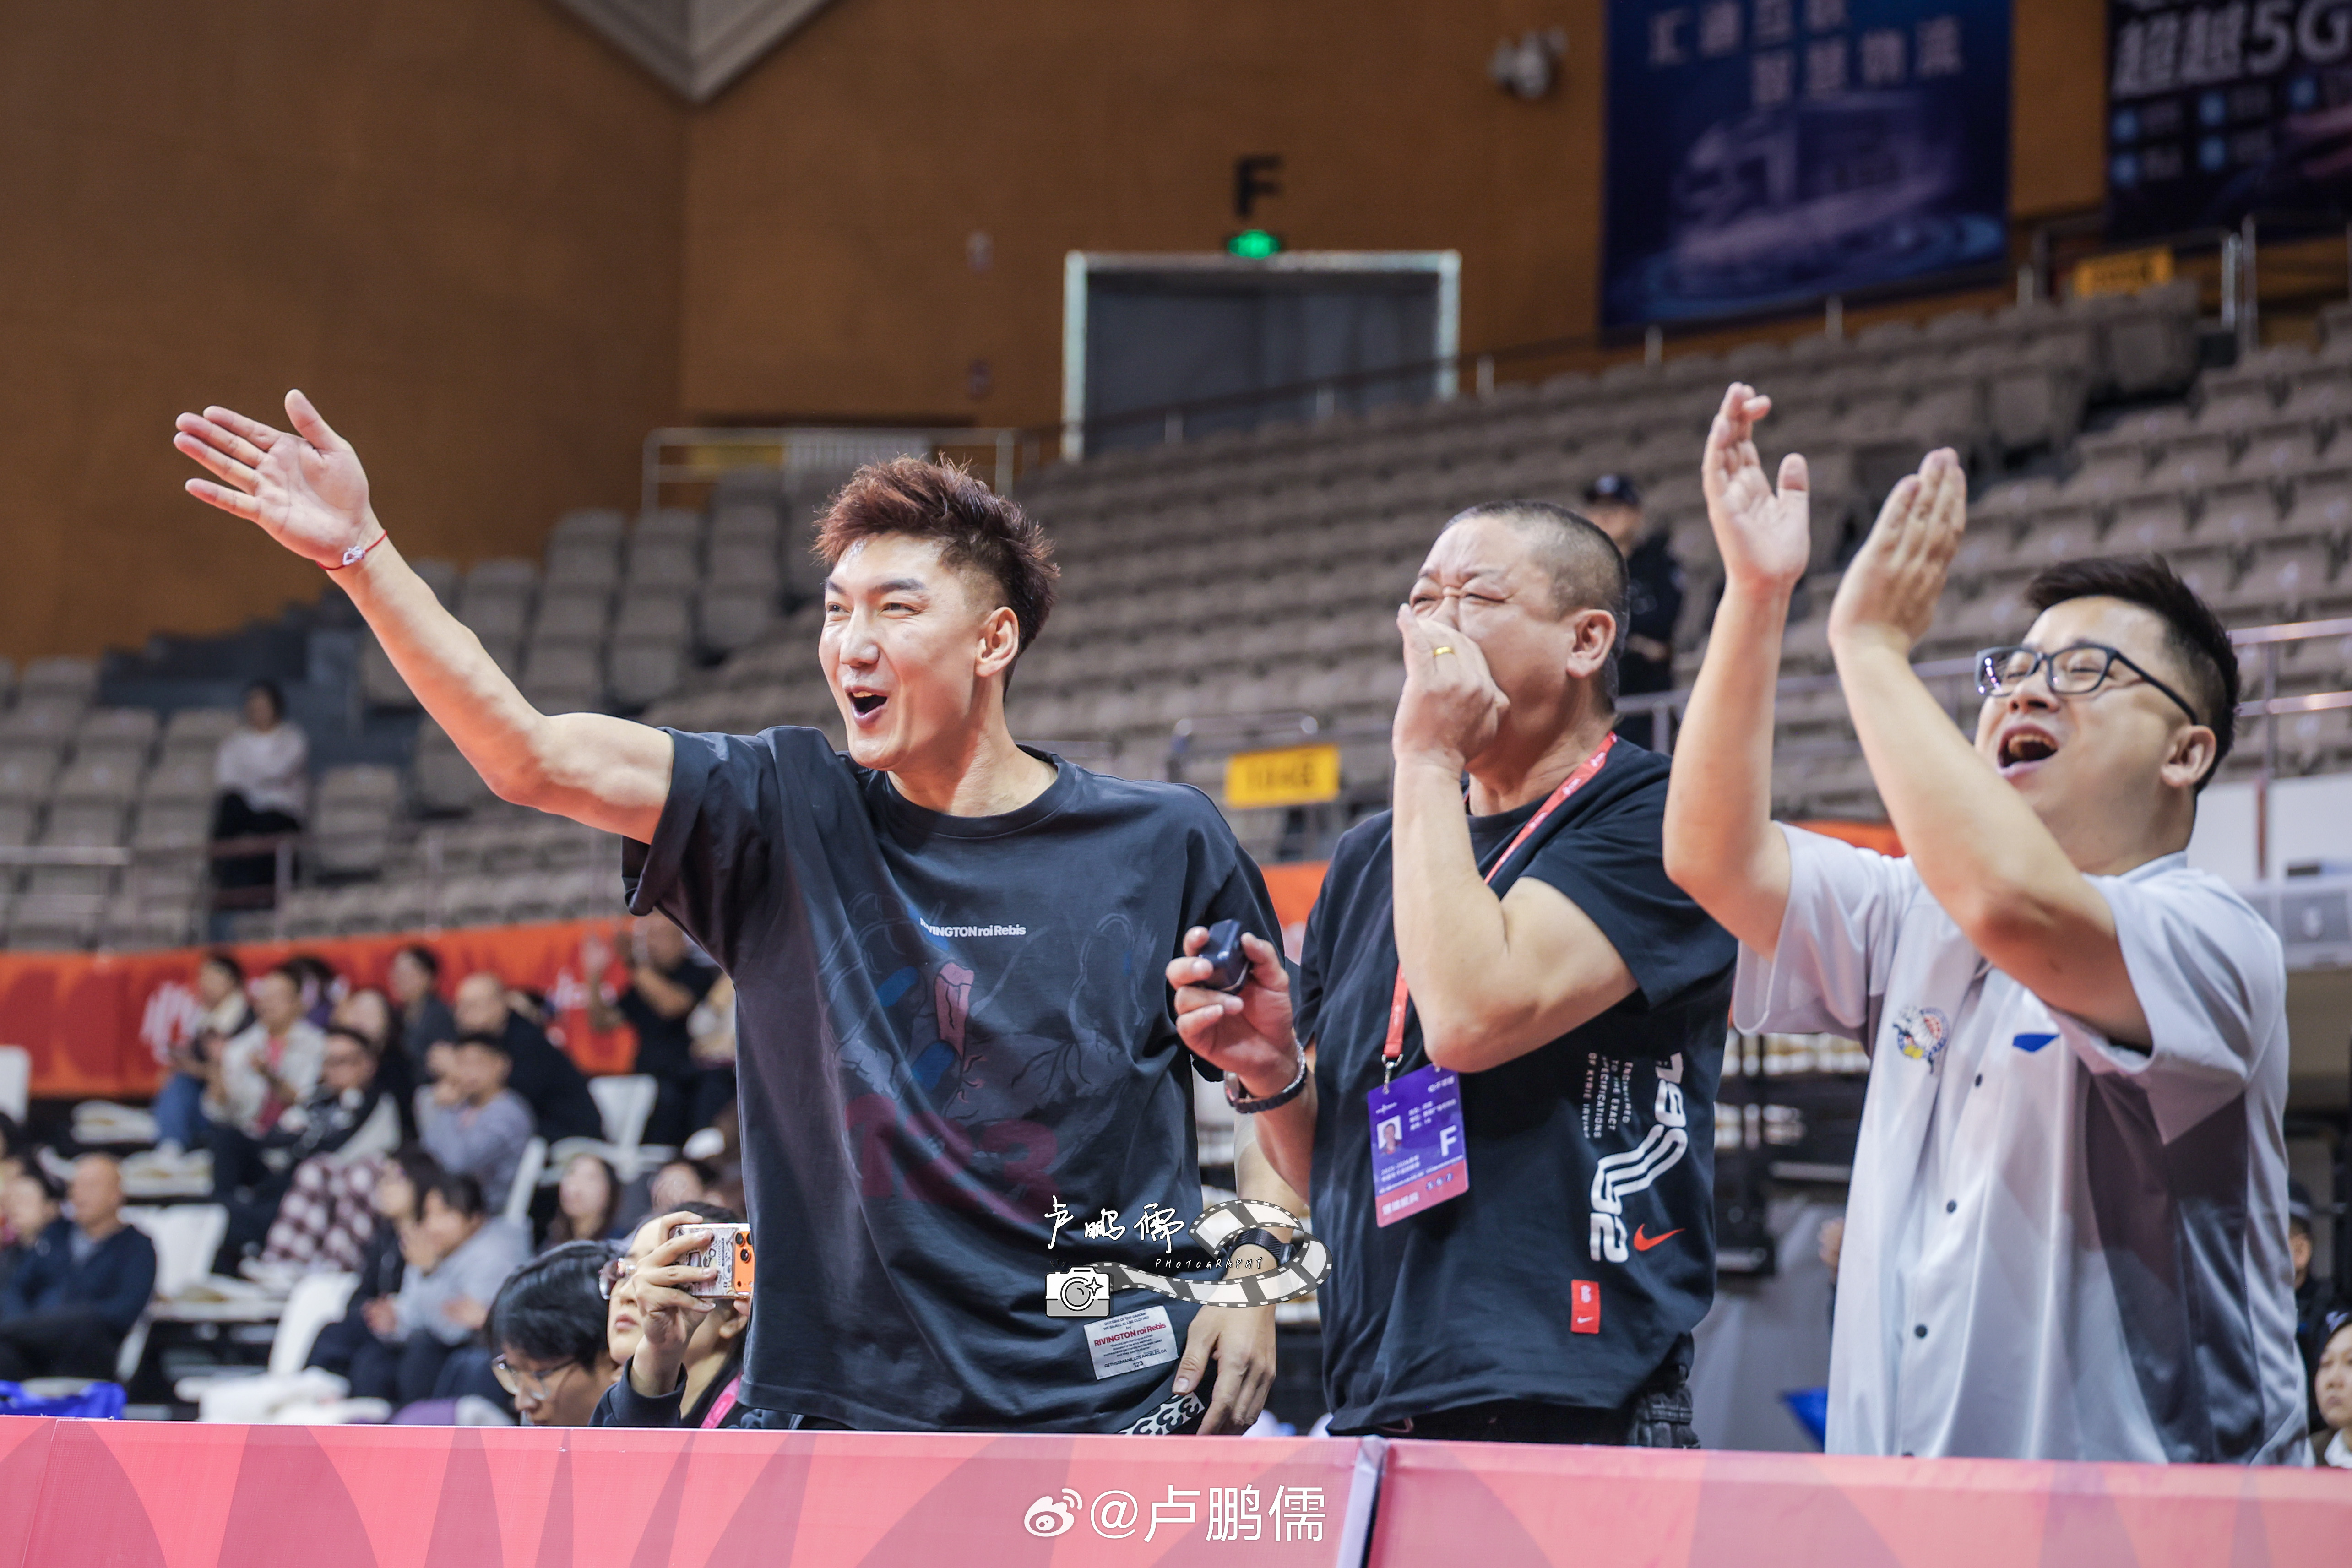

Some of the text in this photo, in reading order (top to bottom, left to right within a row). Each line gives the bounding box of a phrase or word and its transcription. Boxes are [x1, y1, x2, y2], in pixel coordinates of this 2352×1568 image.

[1236, 155, 1282, 220] F
[1439, 1124, 1457, 1157] F
[1094, 1330, 1136, 1346] RIVINGTON
[1136, 1326, 1146, 1335] roi
[1147, 1322, 1166, 1332] Rebis
